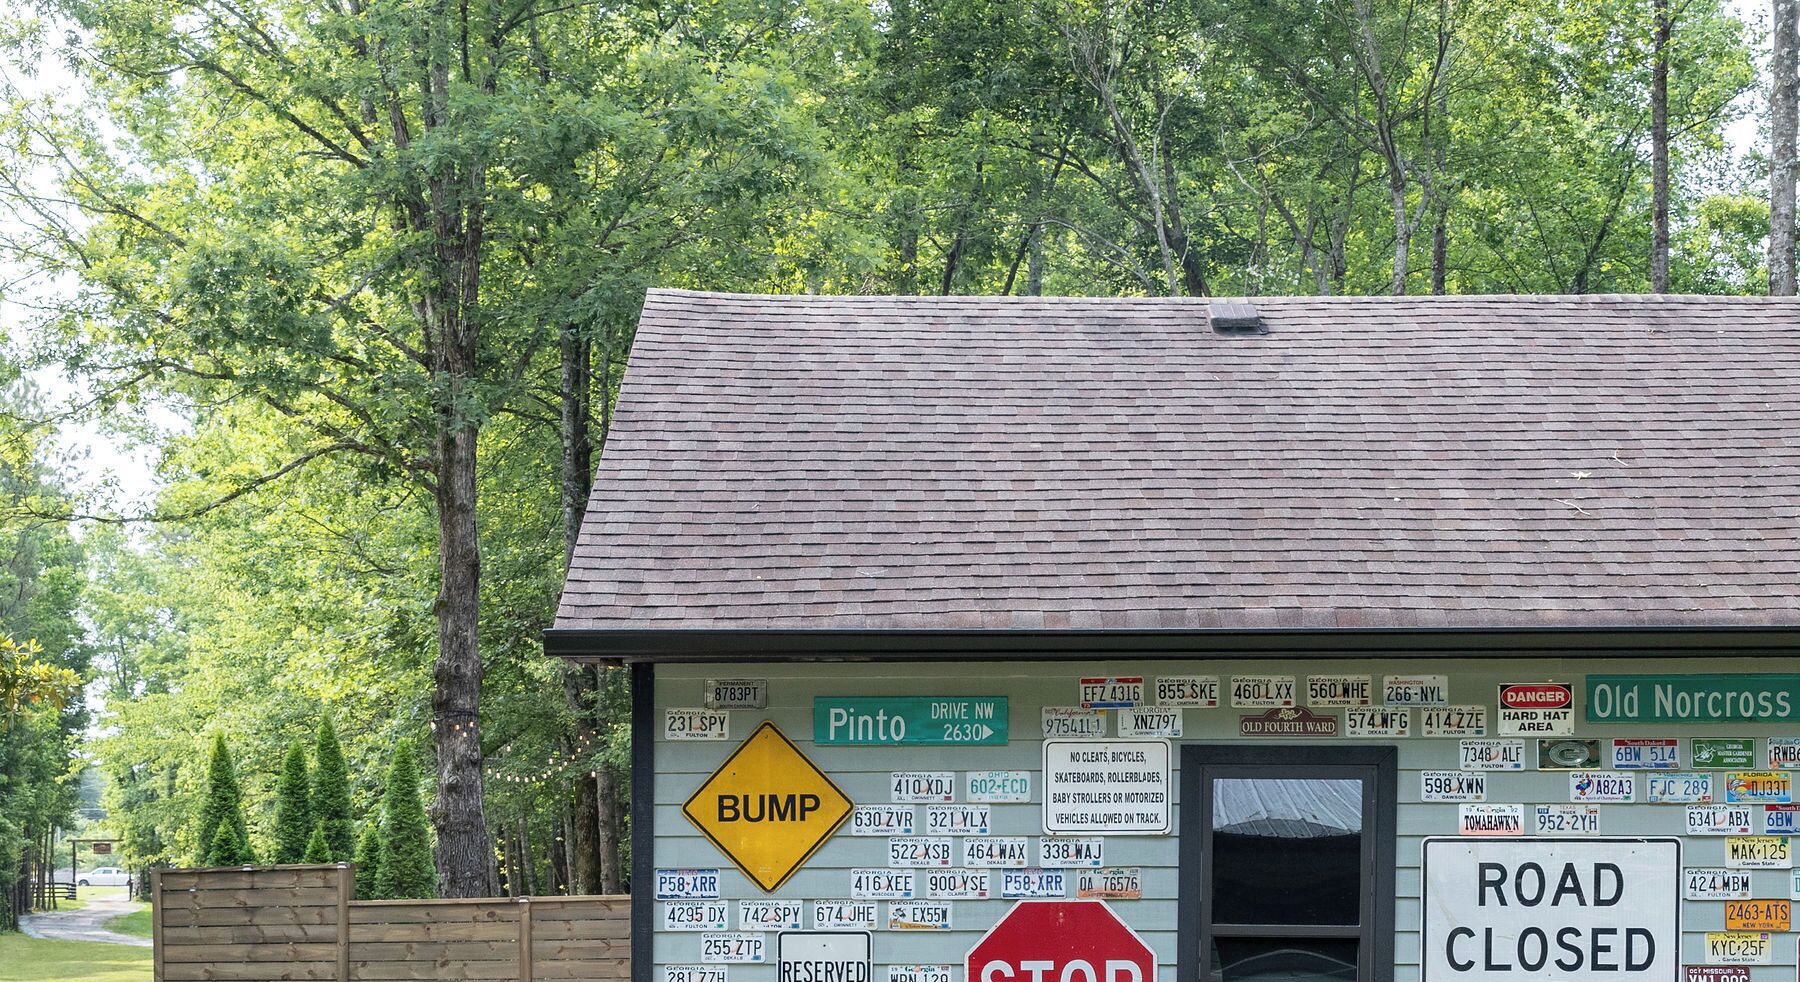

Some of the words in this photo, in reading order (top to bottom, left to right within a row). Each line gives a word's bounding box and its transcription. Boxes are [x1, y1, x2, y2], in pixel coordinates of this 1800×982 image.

[714, 687, 758, 701] 8783PT
[1084, 686, 1106, 702] EFZ
[1111, 686, 1140, 702] 4316
[1387, 687, 1444, 702] 266-NYL
[1508, 692, 1564, 702] DANGER
[1594, 684, 1638, 718] Old
[1655, 684, 1791, 718] Norcross
[931, 703, 969, 719] DRIVE
[974, 703, 994, 719] NW
[1503, 712, 1541, 720] HARD
[1544, 712, 1569, 720] HAT
[668, 715, 693, 732] 231
[701, 715, 726, 732] SPY
[829, 708, 906, 741] Pinto
[1134, 715, 1176, 730] XNZ797
[1242, 722, 1262, 733] OLD
[1265, 722, 1303, 733] FOURTH
[1306, 722, 1335, 733] WARD
[1519, 723, 1553, 732] AREA
[943, 724, 982, 741] 2630
[1070, 752, 1080, 762] NO
[1082, 752, 1110, 764] CLEATS,
[1112, 752, 1146, 764] BICYCLES,
[1463, 747, 1491, 762] 7348
[1502, 747, 1522, 762] ALF
[1616, 748, 1640, 761] 6BW
[1650, 748, 1676, 761] 514
[1055, 772, 1106, 784] SKATEBOARDS,
[1108, 772, 1162, 784] ROLLERBLADES,
[1596, 780, 1632, 794] A82A3
[1752, 782, 1786, 796] DJ33T
[1053, 793, 1070, 804] BABY
[1072, 793, 1111, 804] STROLLERS
[1114, 793, 1123, 804] OR
[1124, 793, 1164, 804] MOTORIZED
[717, 794, 820, 822] BUMP
[1056, 813, 1088, 824] VEHICLES
[1090, 813, 1122, 824] ALLOWED
[1124, 813, 1134, 824] ON
[1136, 813, 1161, 824] TRACK.
[1464, 816, 1519, 830] TOMAHAWK'N
[1689, 812, 1716, 826] 6341
[1729, 812, 1750, 826] ABX
[1767, 812, 1792, 826] 6BW
[1478, 862, 1624, 906] ROAD
[668, 907, 702, 922] 4295
[709, 907, 725, 922] DX
[912, 907, 947, 922] EX55W
[1728, 905, 1788, 920] 2463-ATS
[1446, 927, 1656, 972] CLOSED
